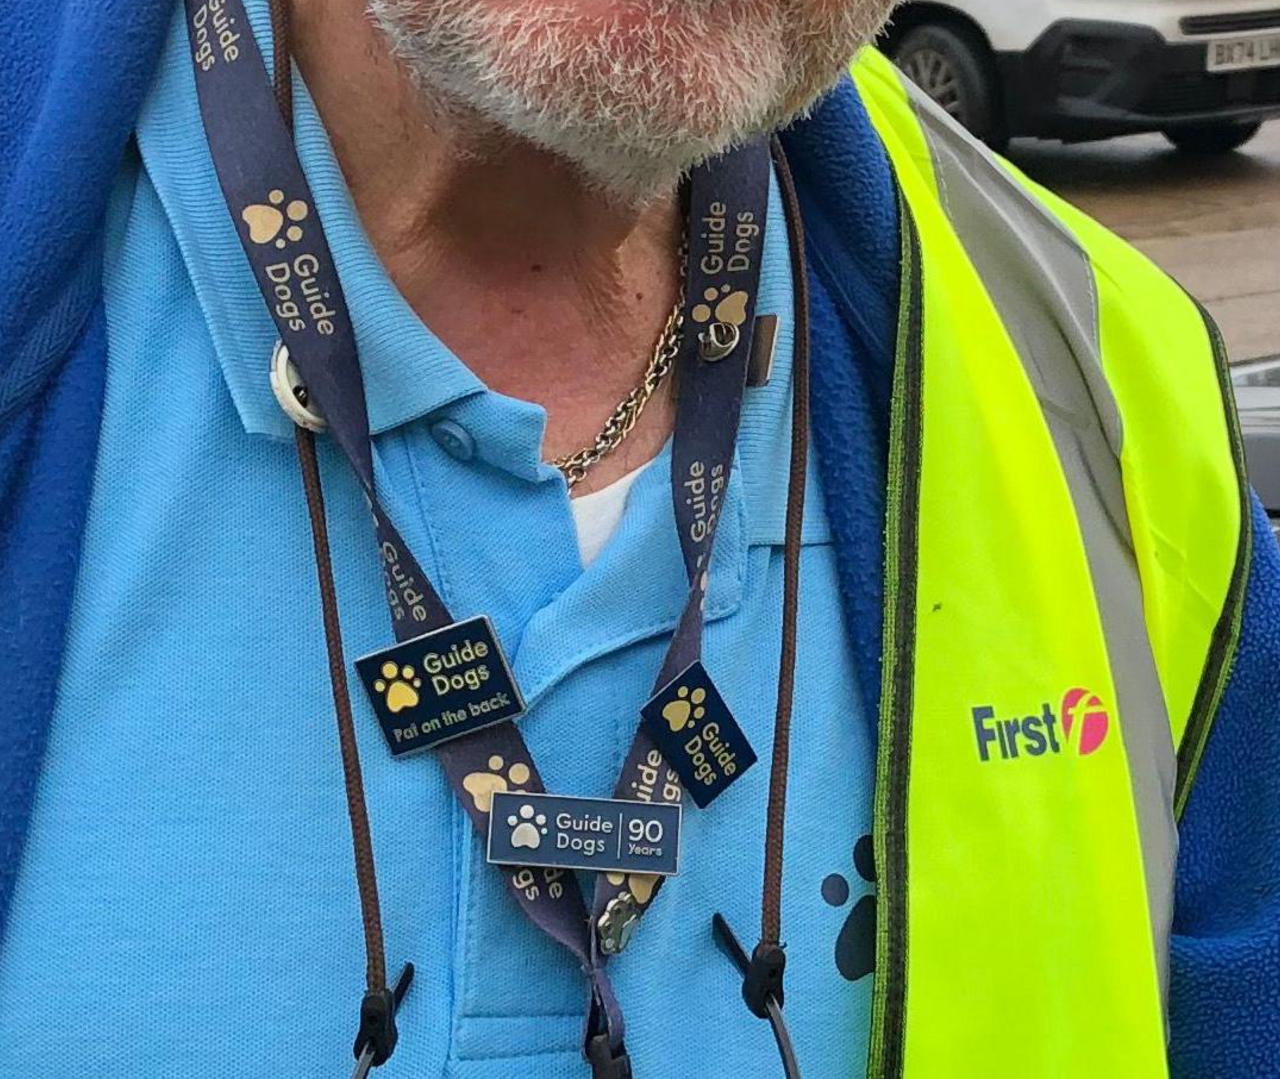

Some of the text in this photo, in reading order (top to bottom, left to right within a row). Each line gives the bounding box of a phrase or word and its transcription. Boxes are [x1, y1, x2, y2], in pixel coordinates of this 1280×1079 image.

[193, 4, 216, 72] Dogs
[701, 201, 727, 275] Guide
[727, 211, 760, 272] Dogs
[265, 262, 306, 332] Dogs
[293, 253, 336, 336] Guide
[684, 460, 707, 543] Guide
[382, 541, 427, 622] Guide
[423, 640, 489, 674] Guide
[431, 664, 490, 696] Dogs
[393, 691, 511, 743] Pat on the back
[971, 703, 1060, 762] First
[684, 735, 717, 786] Dogs
[702, 722, 737, 777] Guide
[556, 812, 664, 843] Guide 90
[556, 832, 663, 857] Dogs Years
